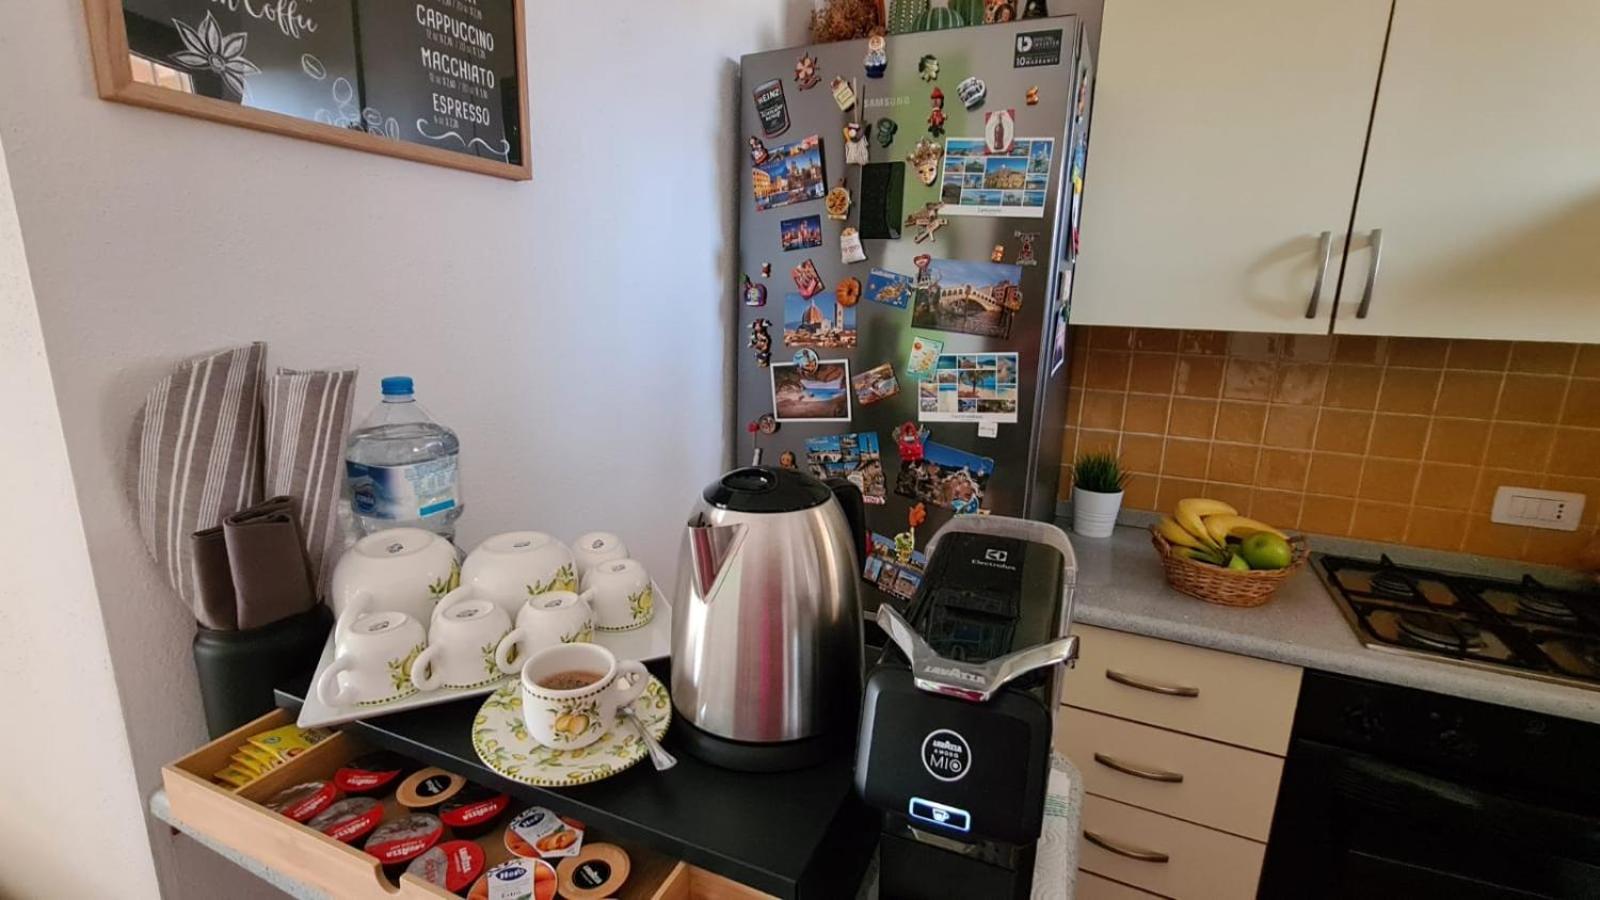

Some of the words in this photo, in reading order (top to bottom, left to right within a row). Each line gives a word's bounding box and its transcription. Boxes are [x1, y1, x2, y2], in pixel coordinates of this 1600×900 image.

[416, 4, 495, 52] CAPPUCCINO
[420, 46, 495, 89] MACCHIATO
[432, 93, 490, 126] ESPRESSO
[757, 89, 781, 104] HEINZ
[930, 754, 962, 773] MIO
